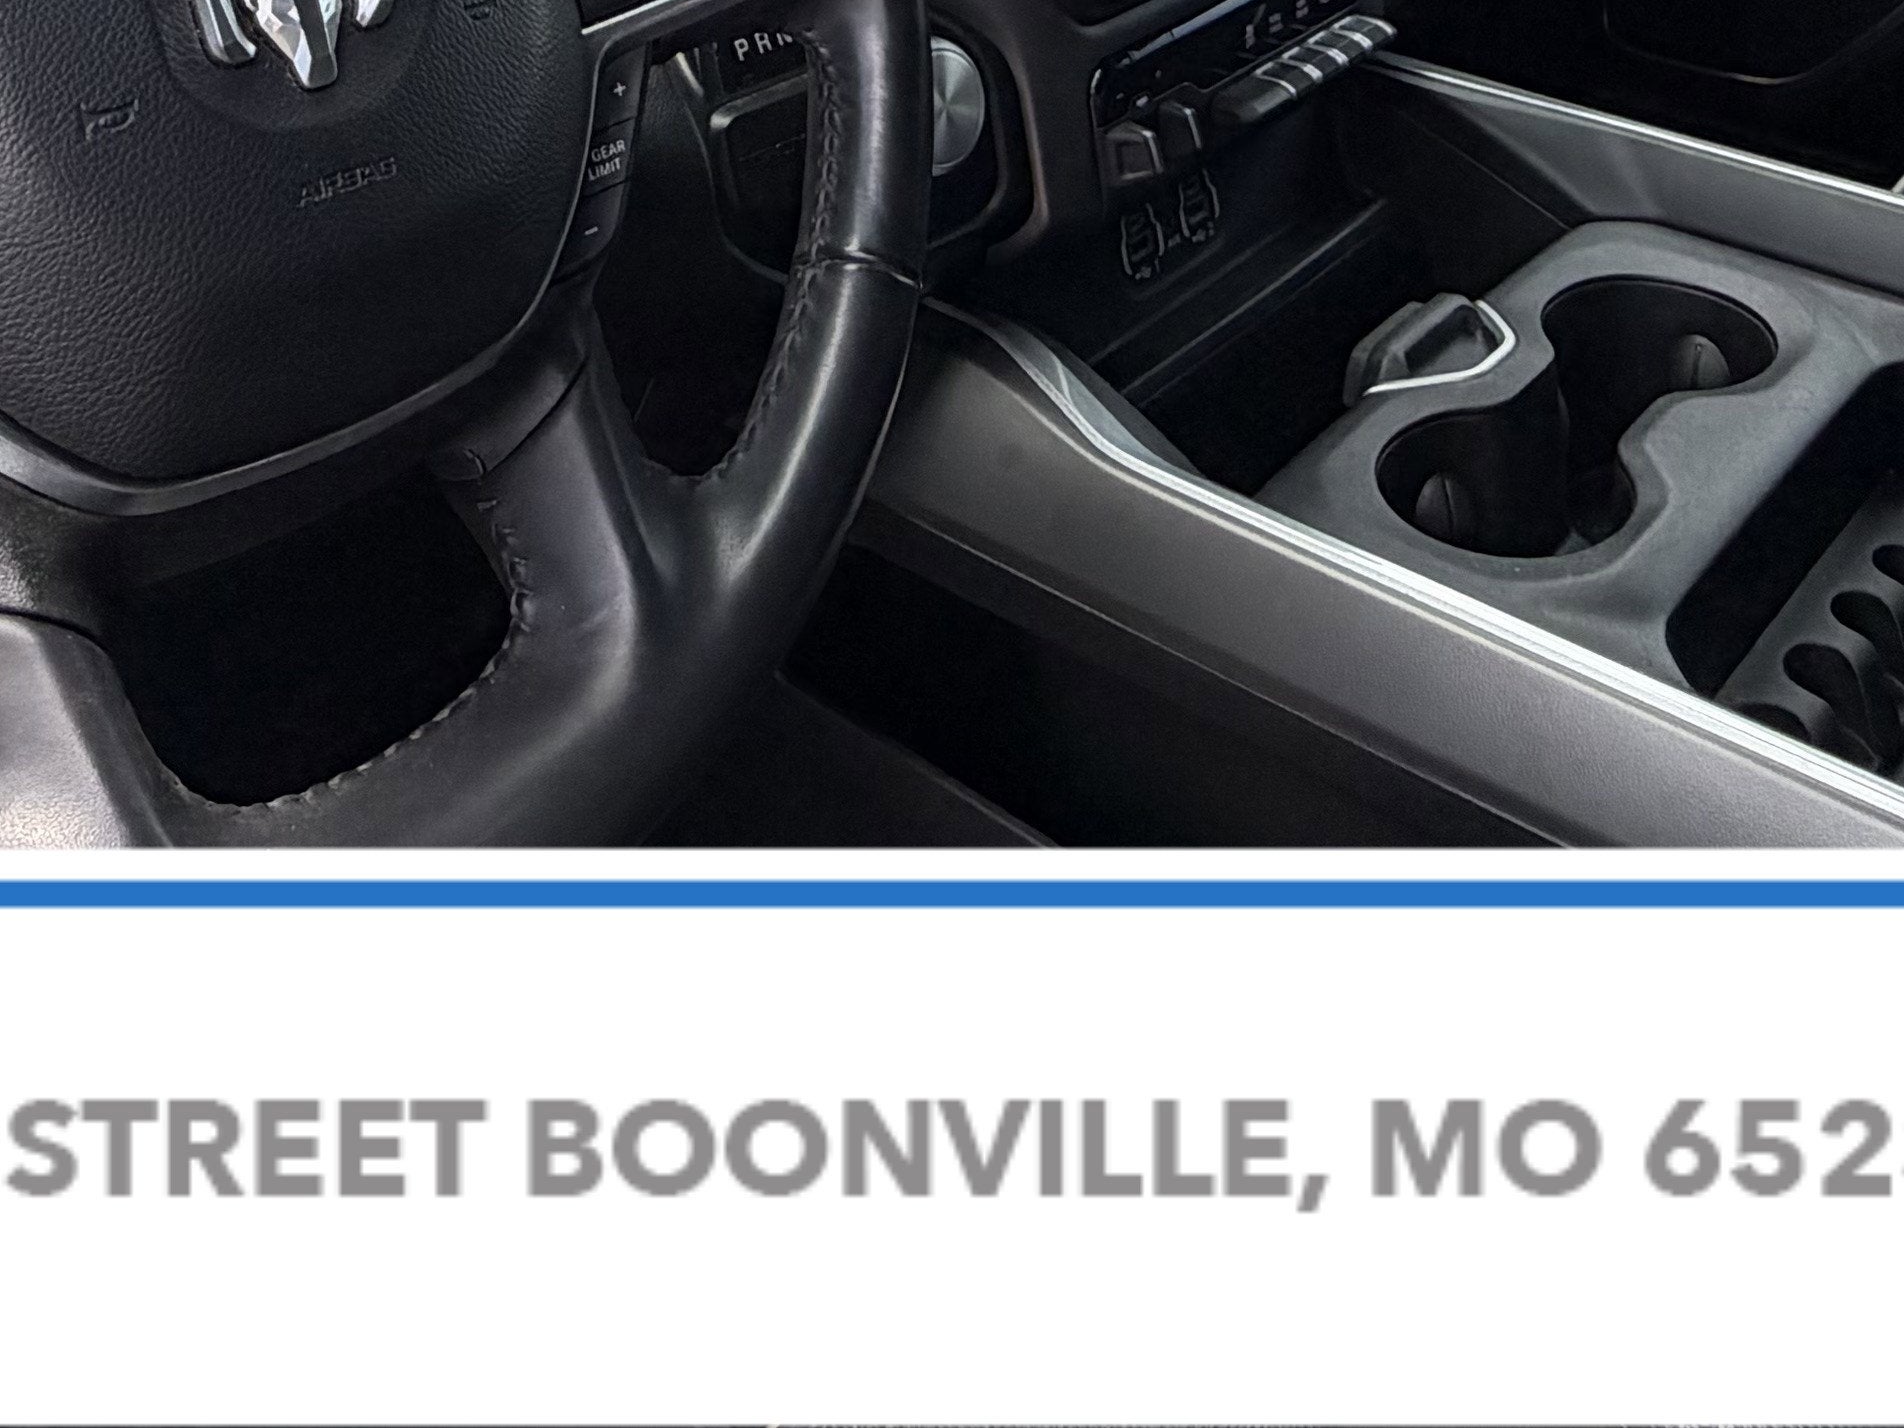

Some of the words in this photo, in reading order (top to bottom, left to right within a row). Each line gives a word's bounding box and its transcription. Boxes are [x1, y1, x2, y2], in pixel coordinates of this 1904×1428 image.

[734, 38, 750, 61] P
[754, 32, 774, 55] R
[591, 139, 626, 162] GEAR
[297, 156, 397, 209] AIRBAG
[588, 157, 622, 182] LIMIT
